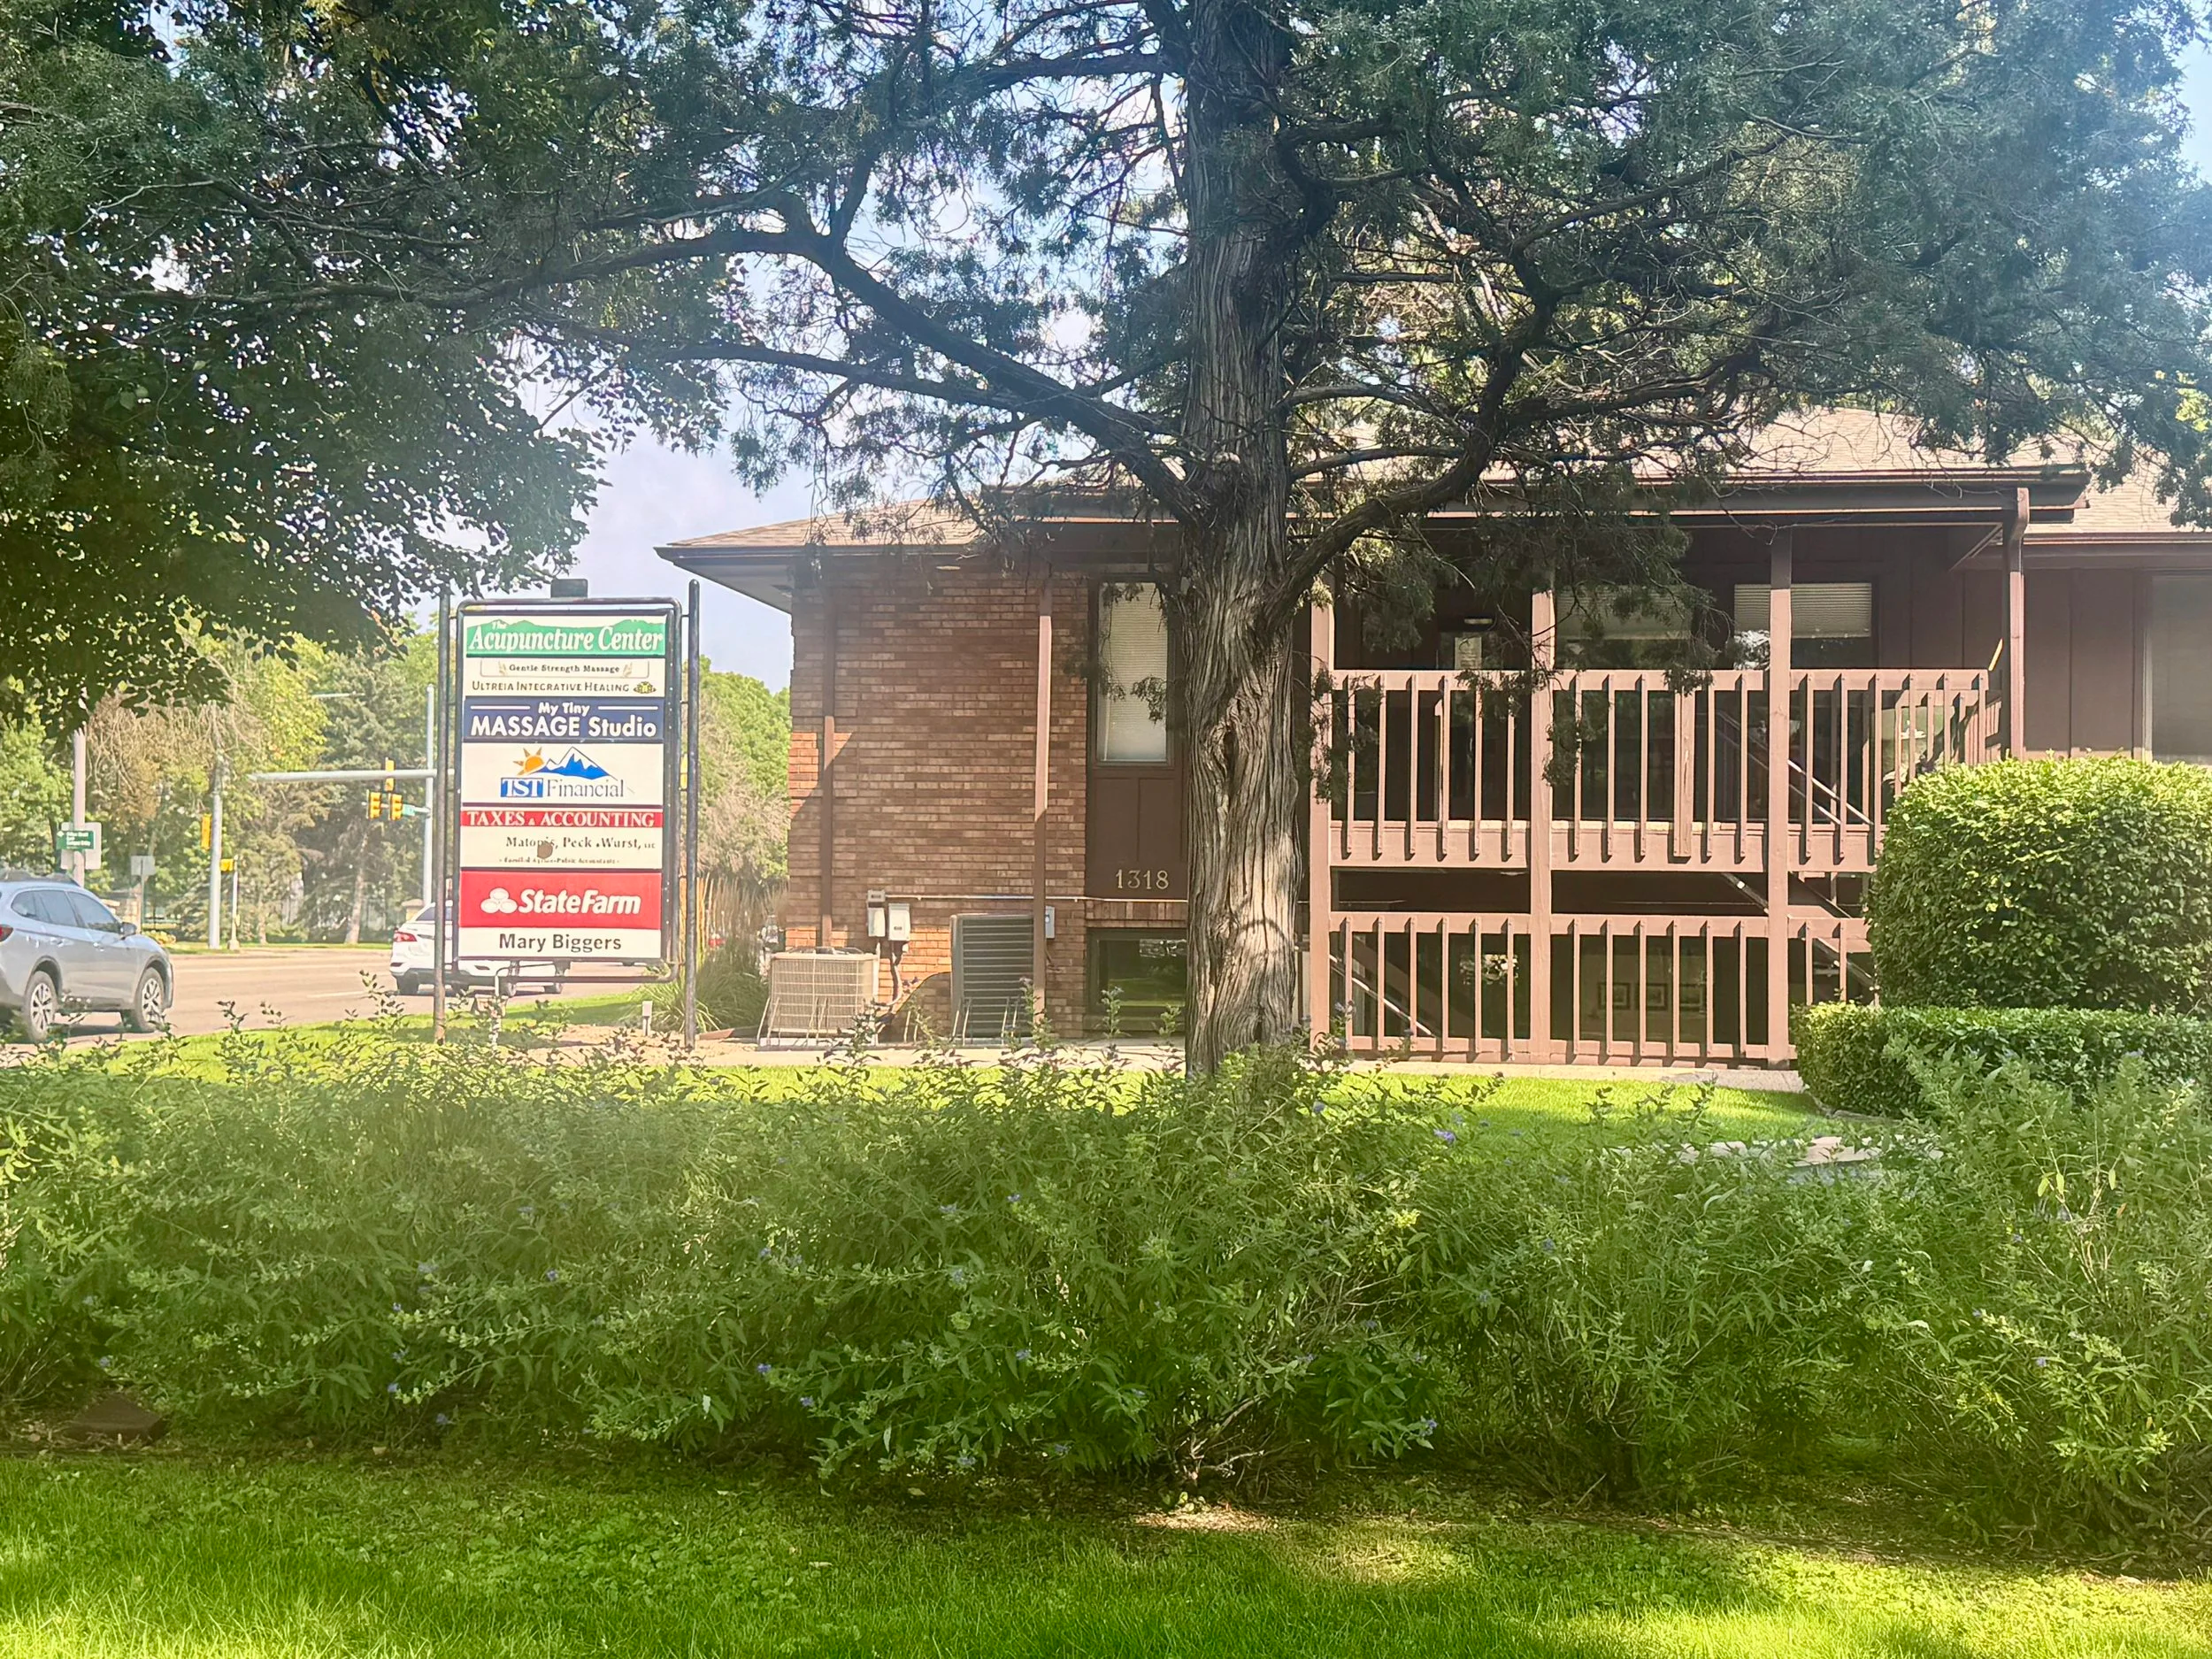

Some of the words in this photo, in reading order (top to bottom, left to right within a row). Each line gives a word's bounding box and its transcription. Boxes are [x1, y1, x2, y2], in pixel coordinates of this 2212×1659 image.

[492, 620, 507, 630] The
[469, 626, 595, 652] Acupuncture
[598, 626, 664, 651] Center
[509, 664, 538, 672] Gentle
[541, 664, 580, 673] Strength
[583, 664, 620, 674] Massage
[584, 681, 630, 692] HEALING
[538, 702, 560, 717] My
[563, 702, 590, 717] Tiny
[471, 715, 580, 737] MASSAGE
[588, 715, 657, 737] Studio
[547, 779, 624, 797] Financial
[466, 810, 526, 826] TAXES
[541, 811, 655, 827] ACCOUNTING
[563, 837, 592, 848] Peck
[1115, 868, 1170, 890] 1318
[518, 888, 641, 915] StateFarm
[499, 933, 546, 951] Mary
[553, 933, 621, 953] Biggers
